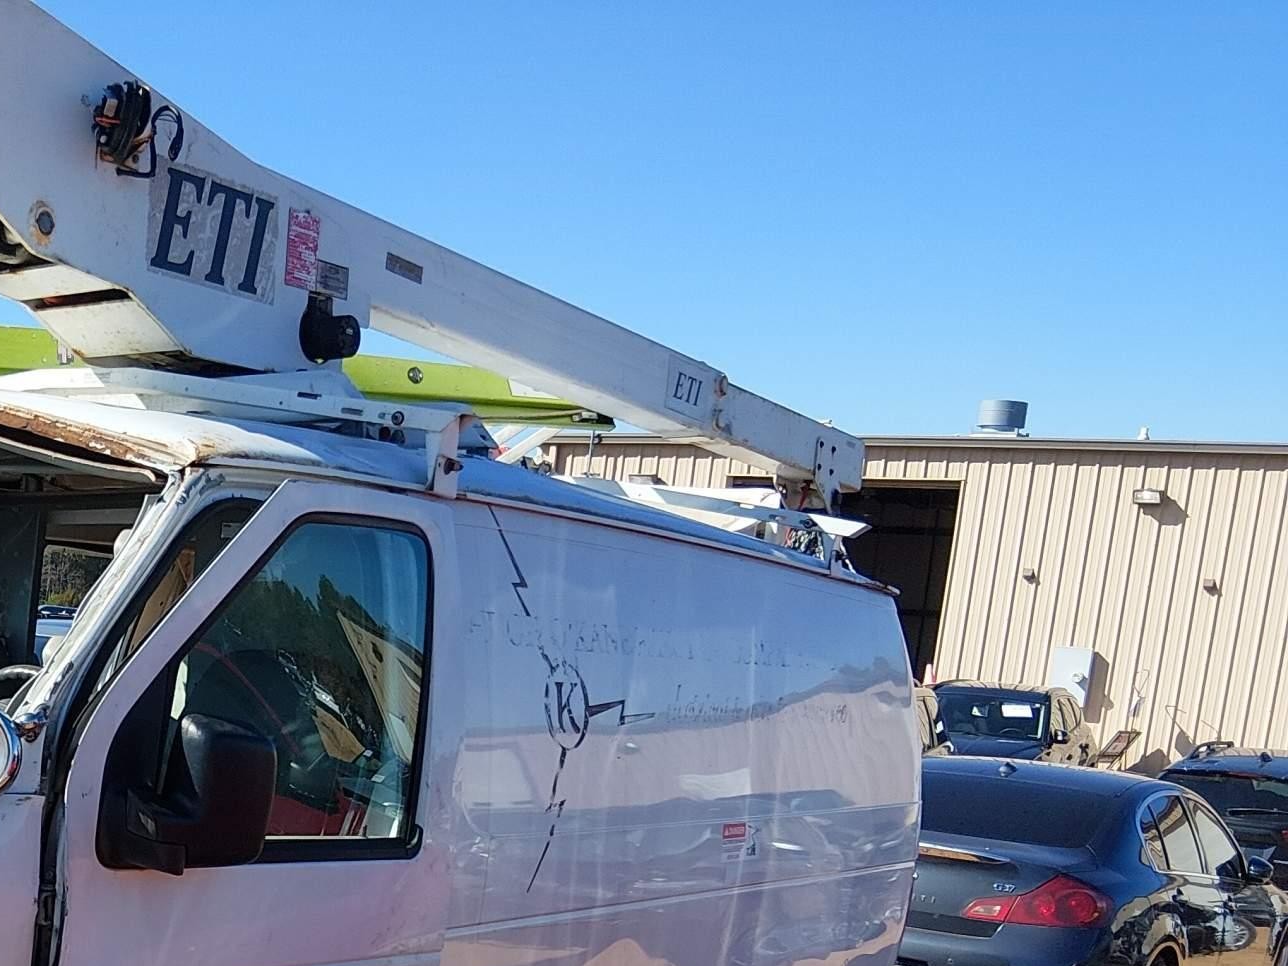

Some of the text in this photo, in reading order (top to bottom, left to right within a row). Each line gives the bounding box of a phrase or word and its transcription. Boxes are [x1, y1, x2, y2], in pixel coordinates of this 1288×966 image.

[150, 167, 275, 295] ETI
[672, 371, 703, 407] ETI
[555, 681, 580, 734] K
